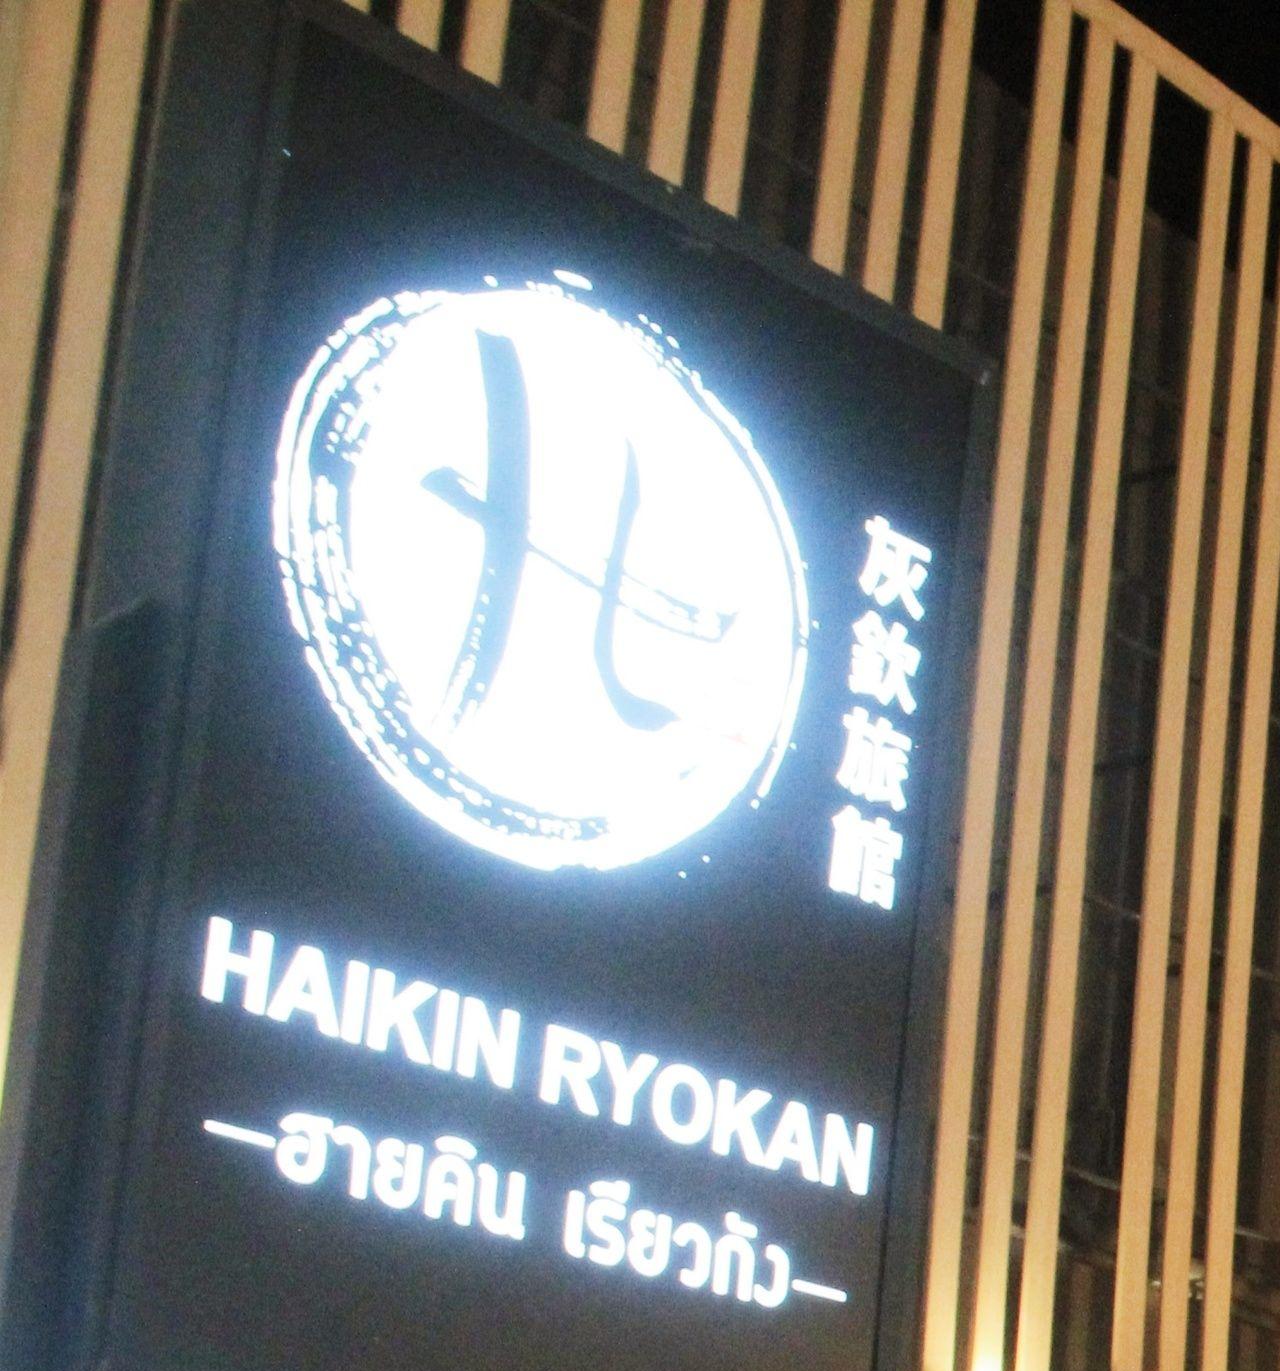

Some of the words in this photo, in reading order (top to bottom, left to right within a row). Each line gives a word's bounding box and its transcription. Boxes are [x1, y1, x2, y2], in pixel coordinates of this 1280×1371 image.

[201, 916, 521, 1090] HAIKIN
[539, 1023, 874, 1196] RYOKAN
[276, 1112, 526, 1241] ฮายคิน
[563, 1180, 790, 1308] เรียวกัง
